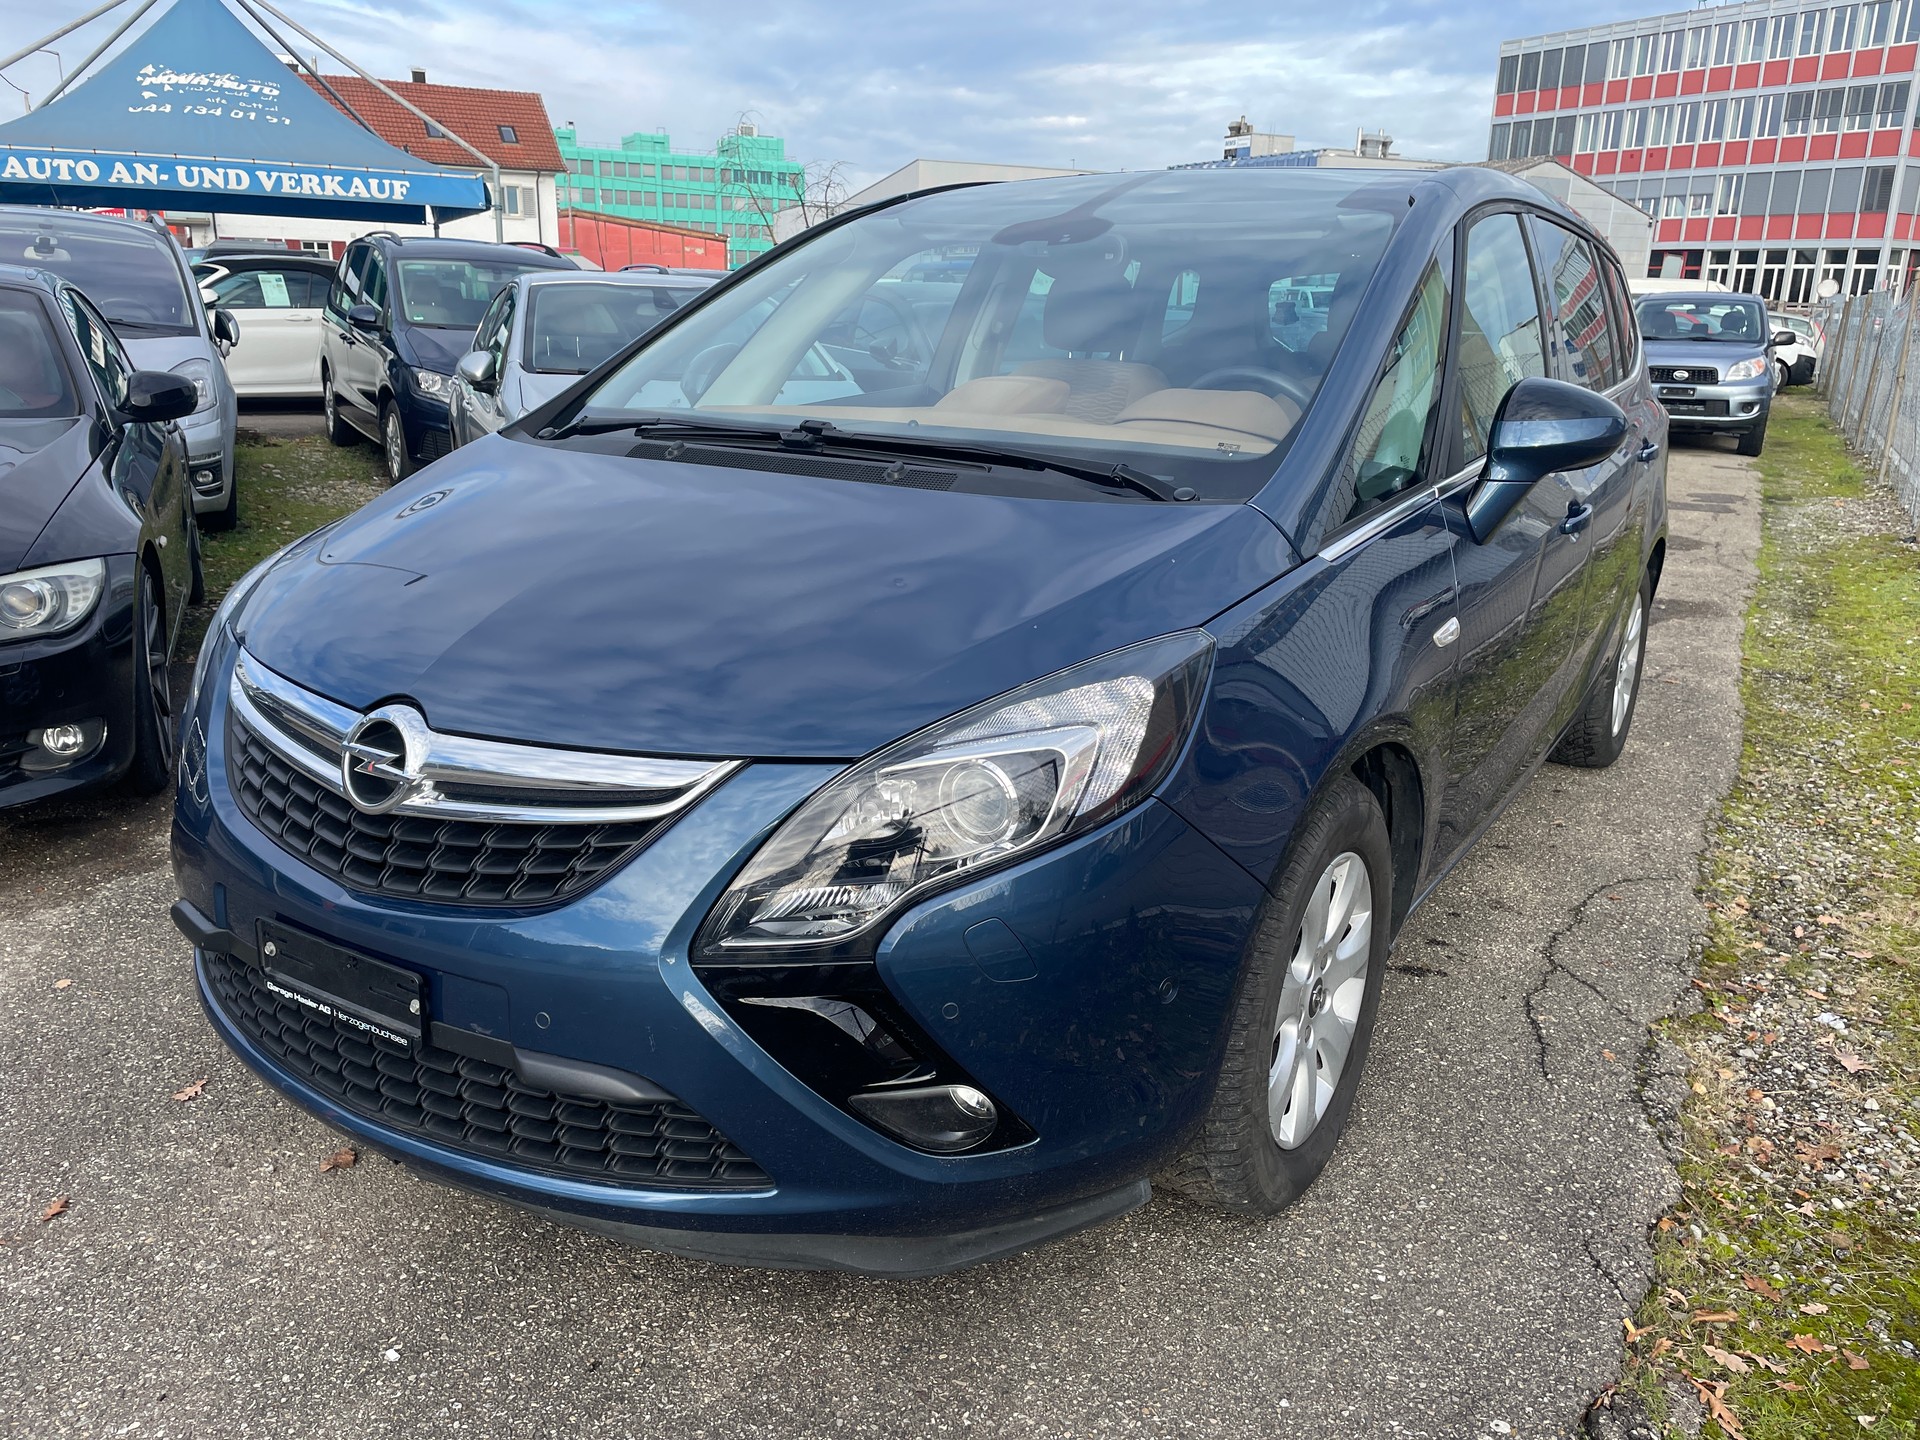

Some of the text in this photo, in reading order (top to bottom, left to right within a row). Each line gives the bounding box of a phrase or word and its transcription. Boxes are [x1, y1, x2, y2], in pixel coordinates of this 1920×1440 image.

[1, 155, 411, 200] AUTO AN- UND VERKAUF
[266, 981, 294, 999] Garage
[333, 1009, 408, 1047] Herzogenbuchsee
